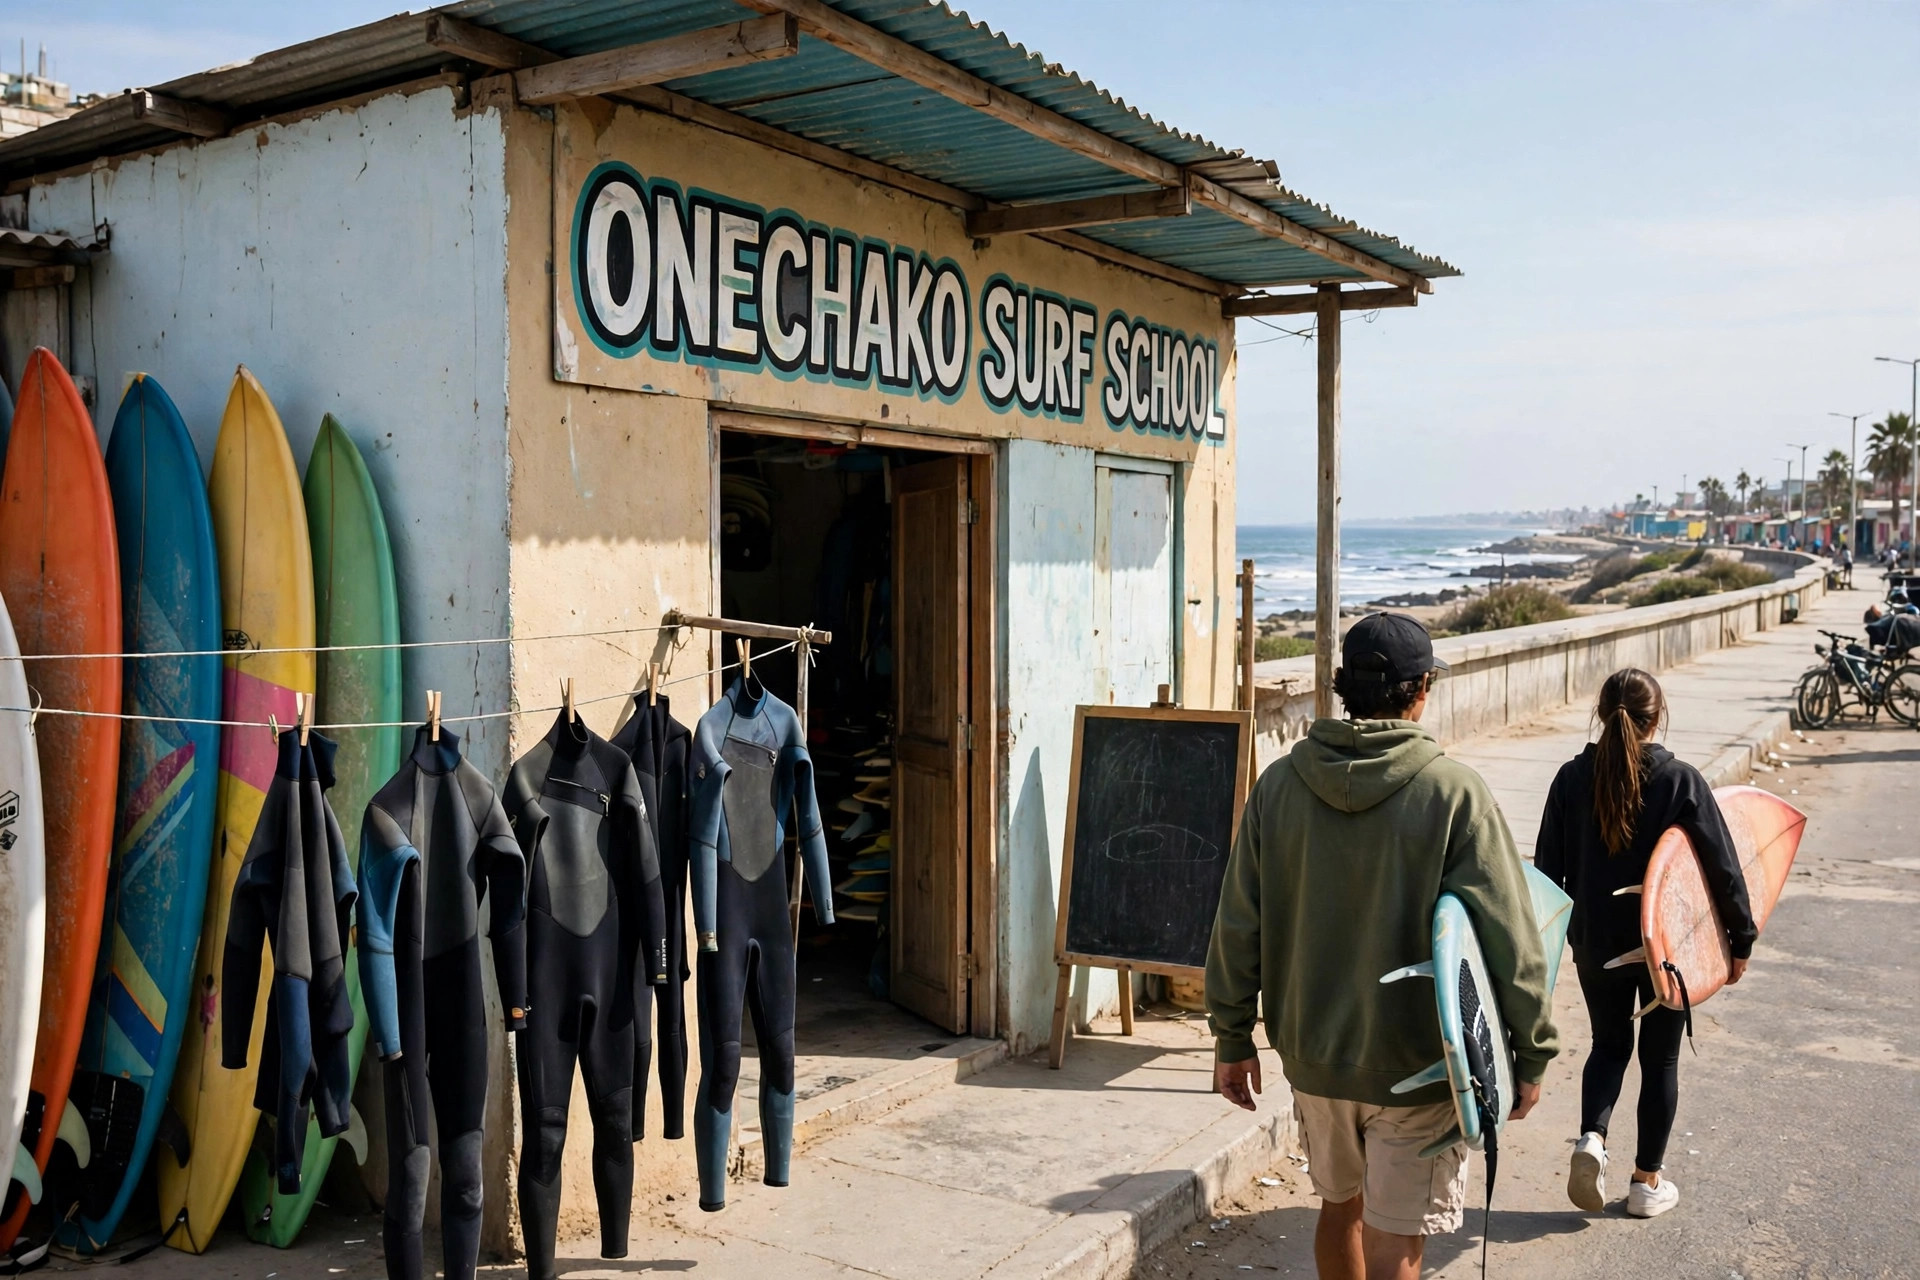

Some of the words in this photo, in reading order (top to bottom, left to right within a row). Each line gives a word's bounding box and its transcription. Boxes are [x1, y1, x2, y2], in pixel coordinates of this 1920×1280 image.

[583, 178, 969, 390] ONECHAKO
[981, 284, 1096, 410] SURF
[1103, 318, 1226, 436] SCHOOL
